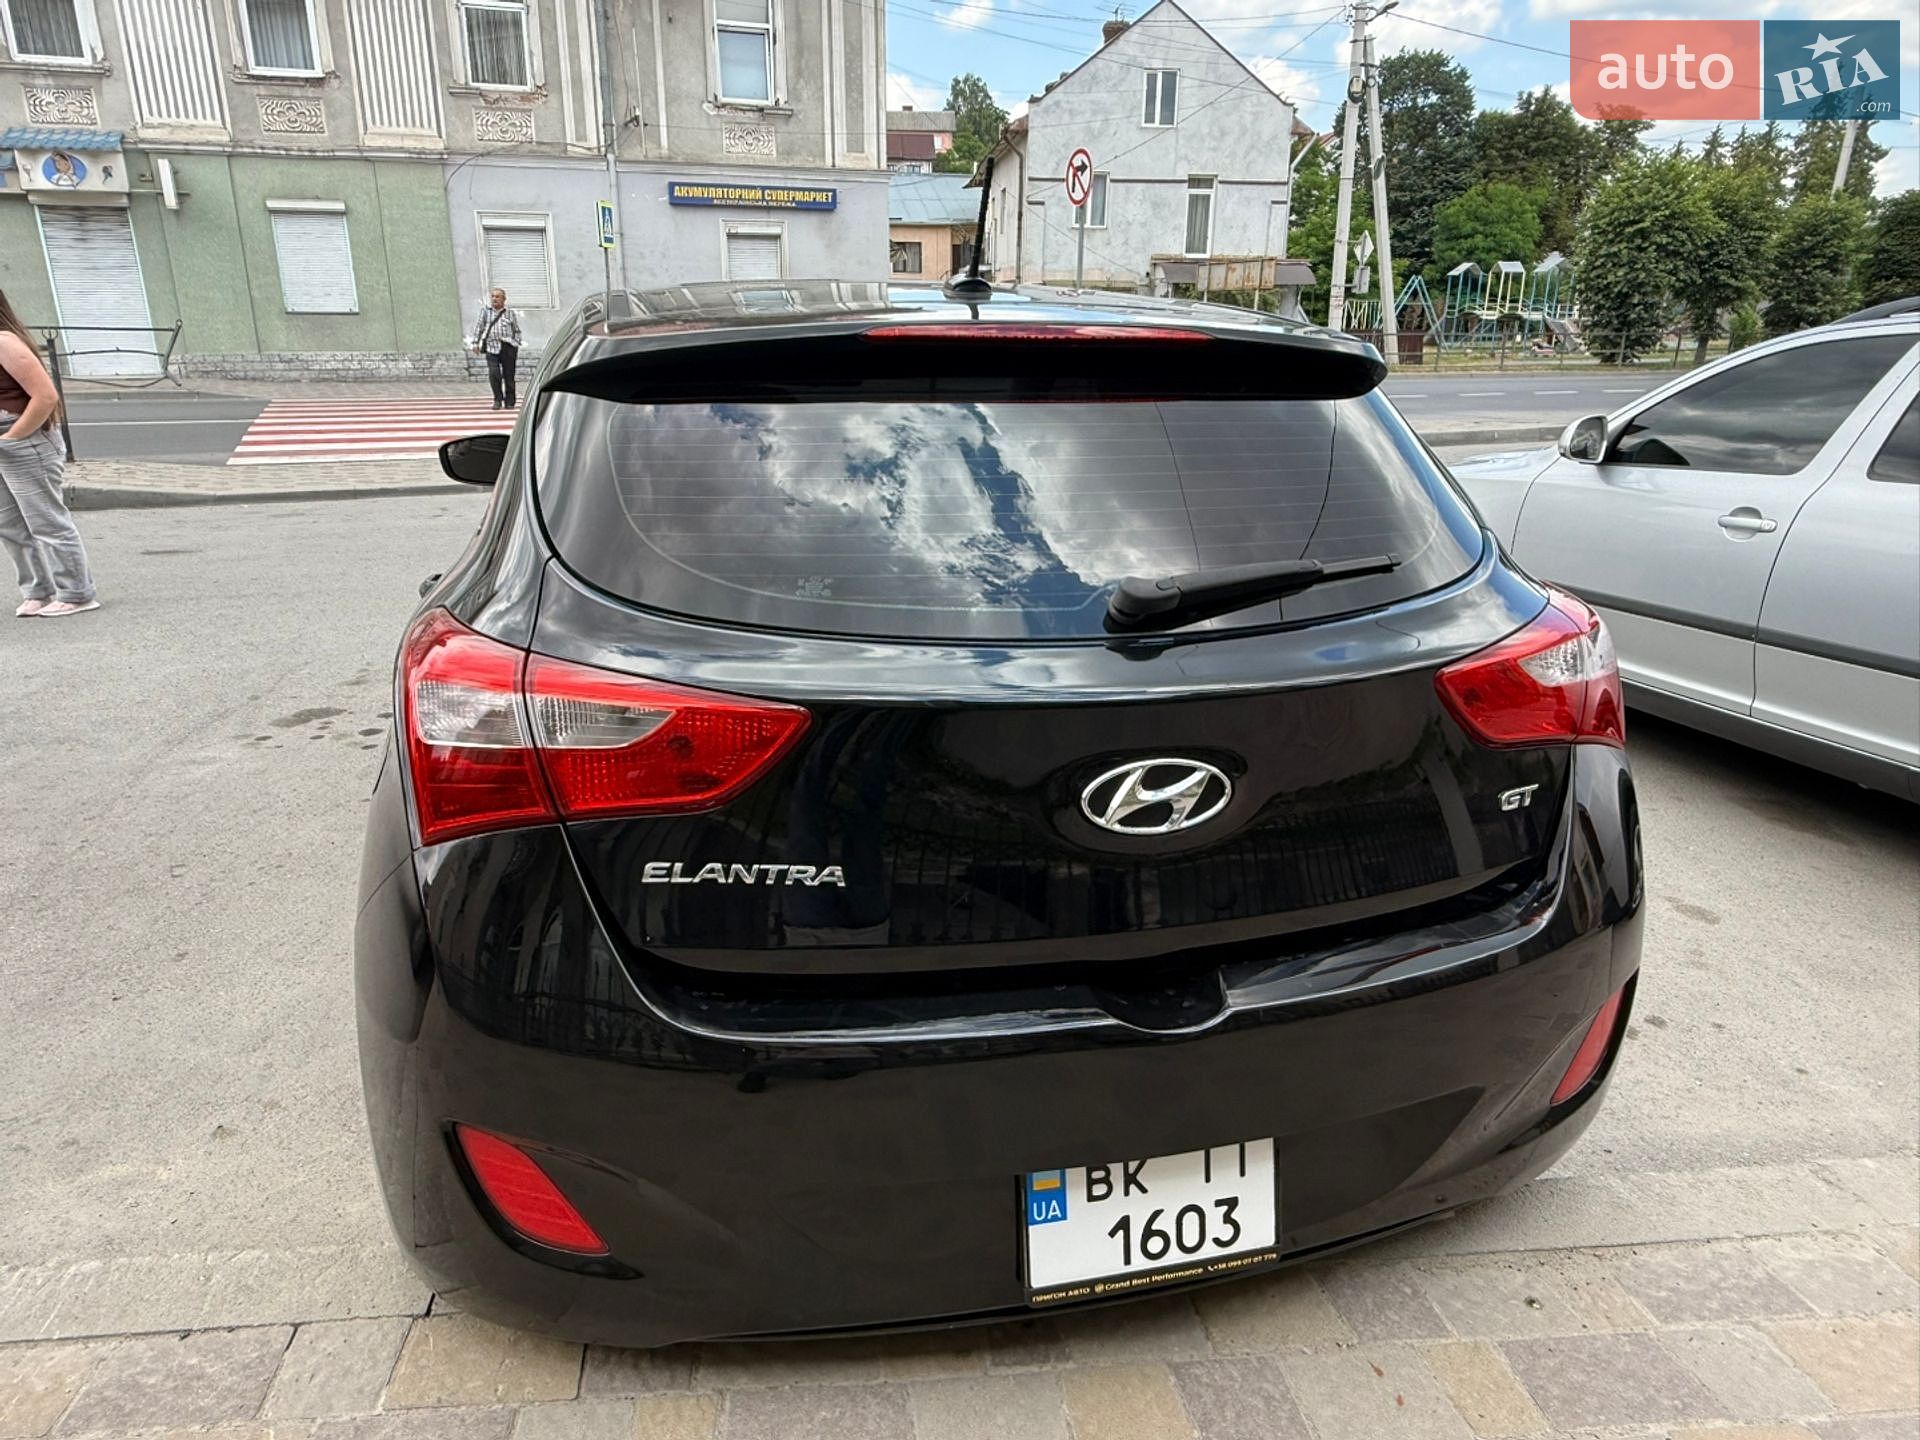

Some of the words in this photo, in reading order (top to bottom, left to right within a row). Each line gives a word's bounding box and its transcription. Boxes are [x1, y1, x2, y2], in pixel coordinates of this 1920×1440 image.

[674, 185, 763, 200] АКУМУЛЯТОРНИЙ
[764, 189, 833, 203] СУПЕРМАРКЕТ
[1501, 784, 1539, 811] GT
[641, 861, 847, 887] ELANTRA
[1087, 1159, 1149, 1203] BK
[1033, 1200, 1062, 1221] UA
[1108, 1196, 1241, 1266] 1603
[1151, 1267, 1204, 1282] Performance
